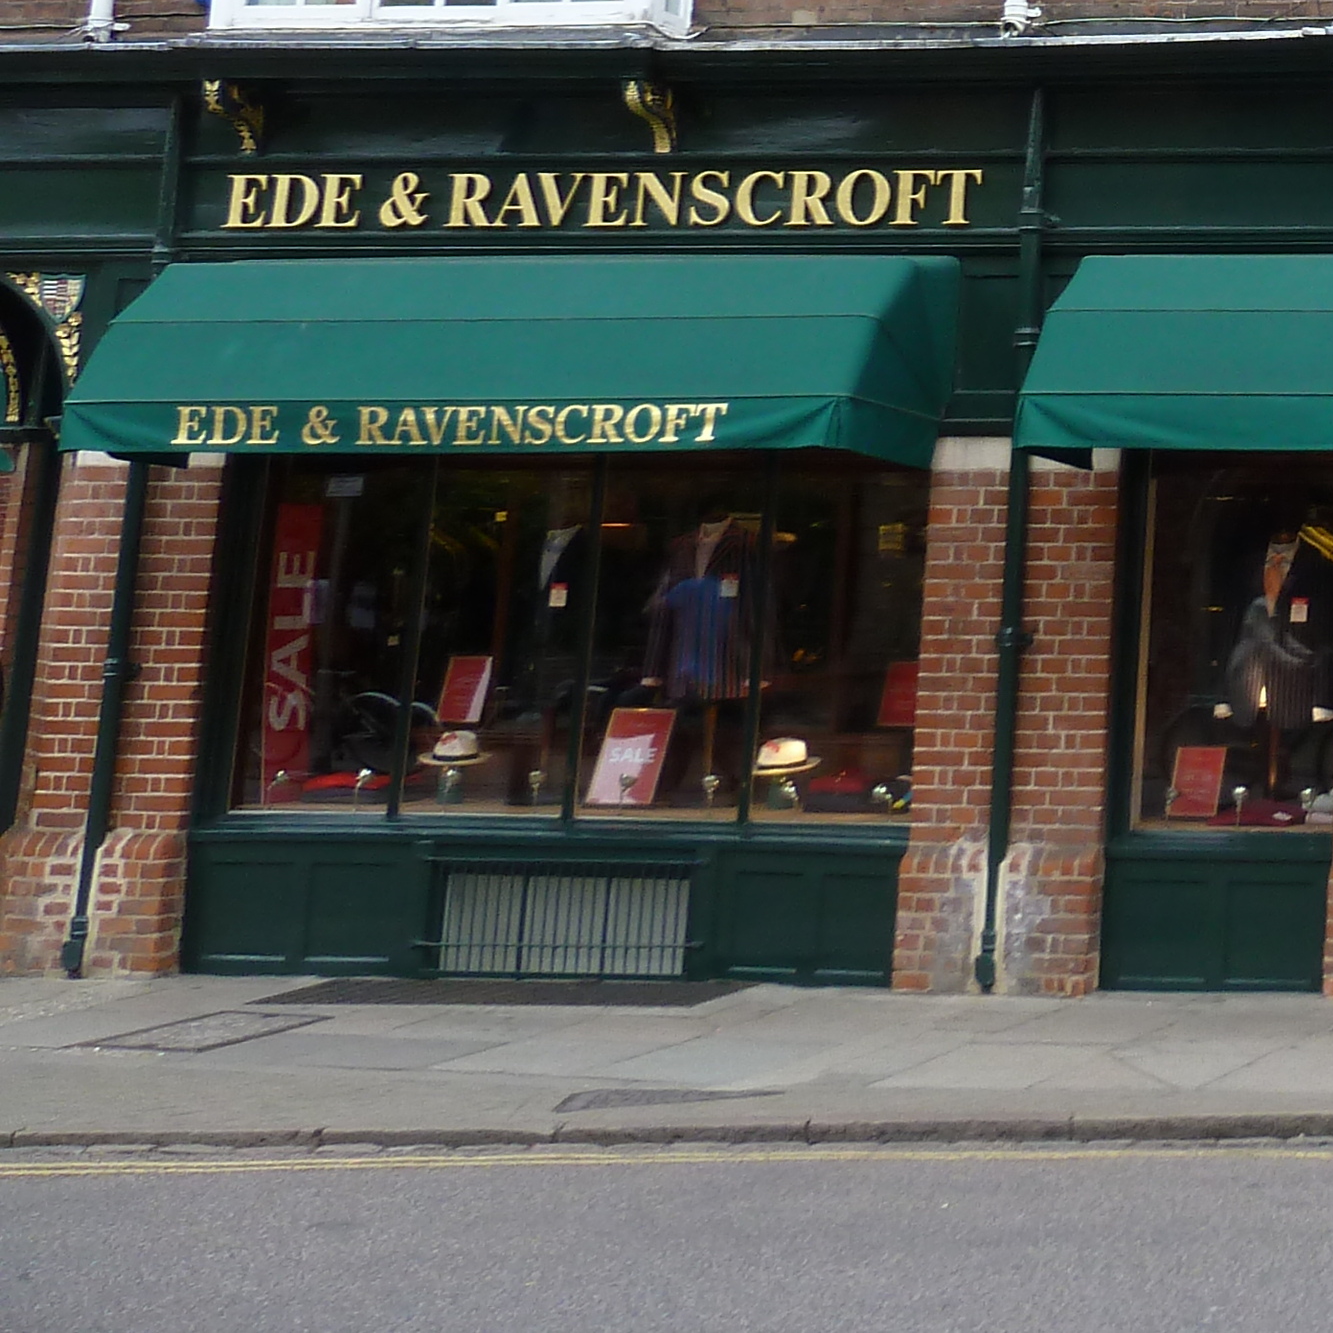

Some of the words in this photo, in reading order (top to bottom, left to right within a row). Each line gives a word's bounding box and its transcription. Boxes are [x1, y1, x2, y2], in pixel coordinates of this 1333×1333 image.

[221, 173, 363, 228] EDE
[379, 171, 429, 226] &
[444, 169, 983, 227] RAVENSCROFT
[170, 406, 279, 445] EDE
[302, 406, 340, 445] &
[354, 402, 729, 445] RAVENSCROFT
[267, 550, 316, 731] SALE
[609, 747, 658, 763] SALE
